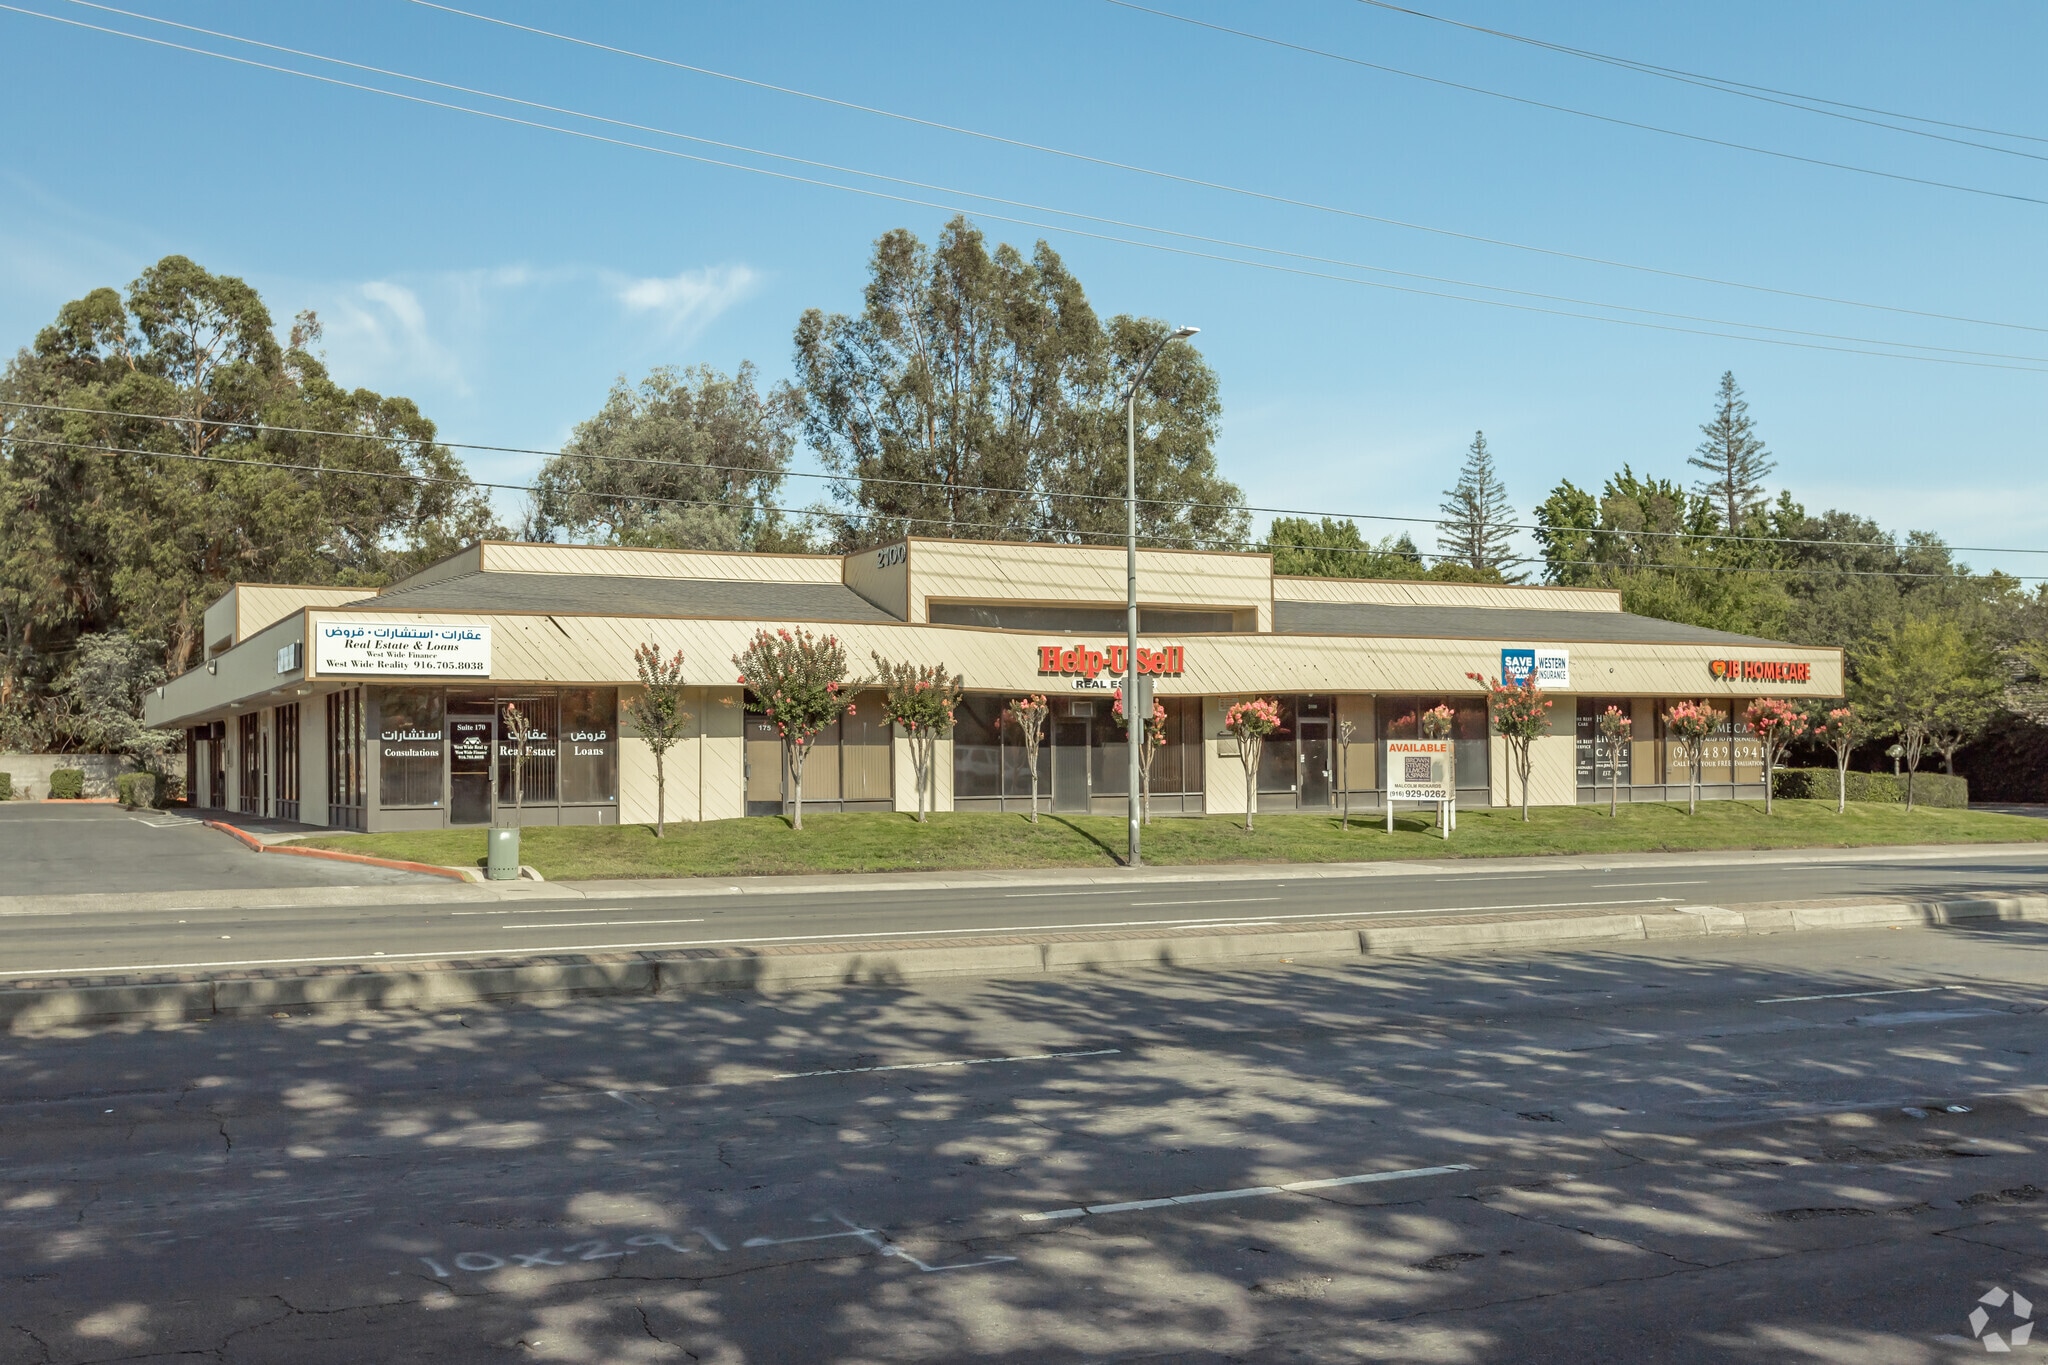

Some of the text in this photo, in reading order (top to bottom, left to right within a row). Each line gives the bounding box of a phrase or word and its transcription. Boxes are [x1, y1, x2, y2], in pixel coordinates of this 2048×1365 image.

[877, 543, 906, 569] 2100
[325, 627, 482, 641] عقارات استشارات قروض
[344, 639, 459, 651] Real Estate & Loans
[366, 650, 384, 658] West
[326, 659, 484, 671] West Wide Reality 916.705.8038
[1039, 645, 1185, 679] Help-USell
[1505, 656, 1533, 667] SAVE
[1538, 657, 1566, 669] WESTERN
[1508, 666, 1530, 674] NOW
[1538, 670, 1567, 680] INSURANCE
[1726, 660, 1811, 680] JB HOMECARE
[381, 729, 441, 743] استشارات
[570, 730, 607, 742] قروض
[384, 748, 439, 757] Consultations
[525, 746, 556, 756] Estate
[574, 746, 604, 756] Loans
[1389, 743, 1447, 752] AVAILABLE
[1405, 790, 1446, 798] 929-0262
